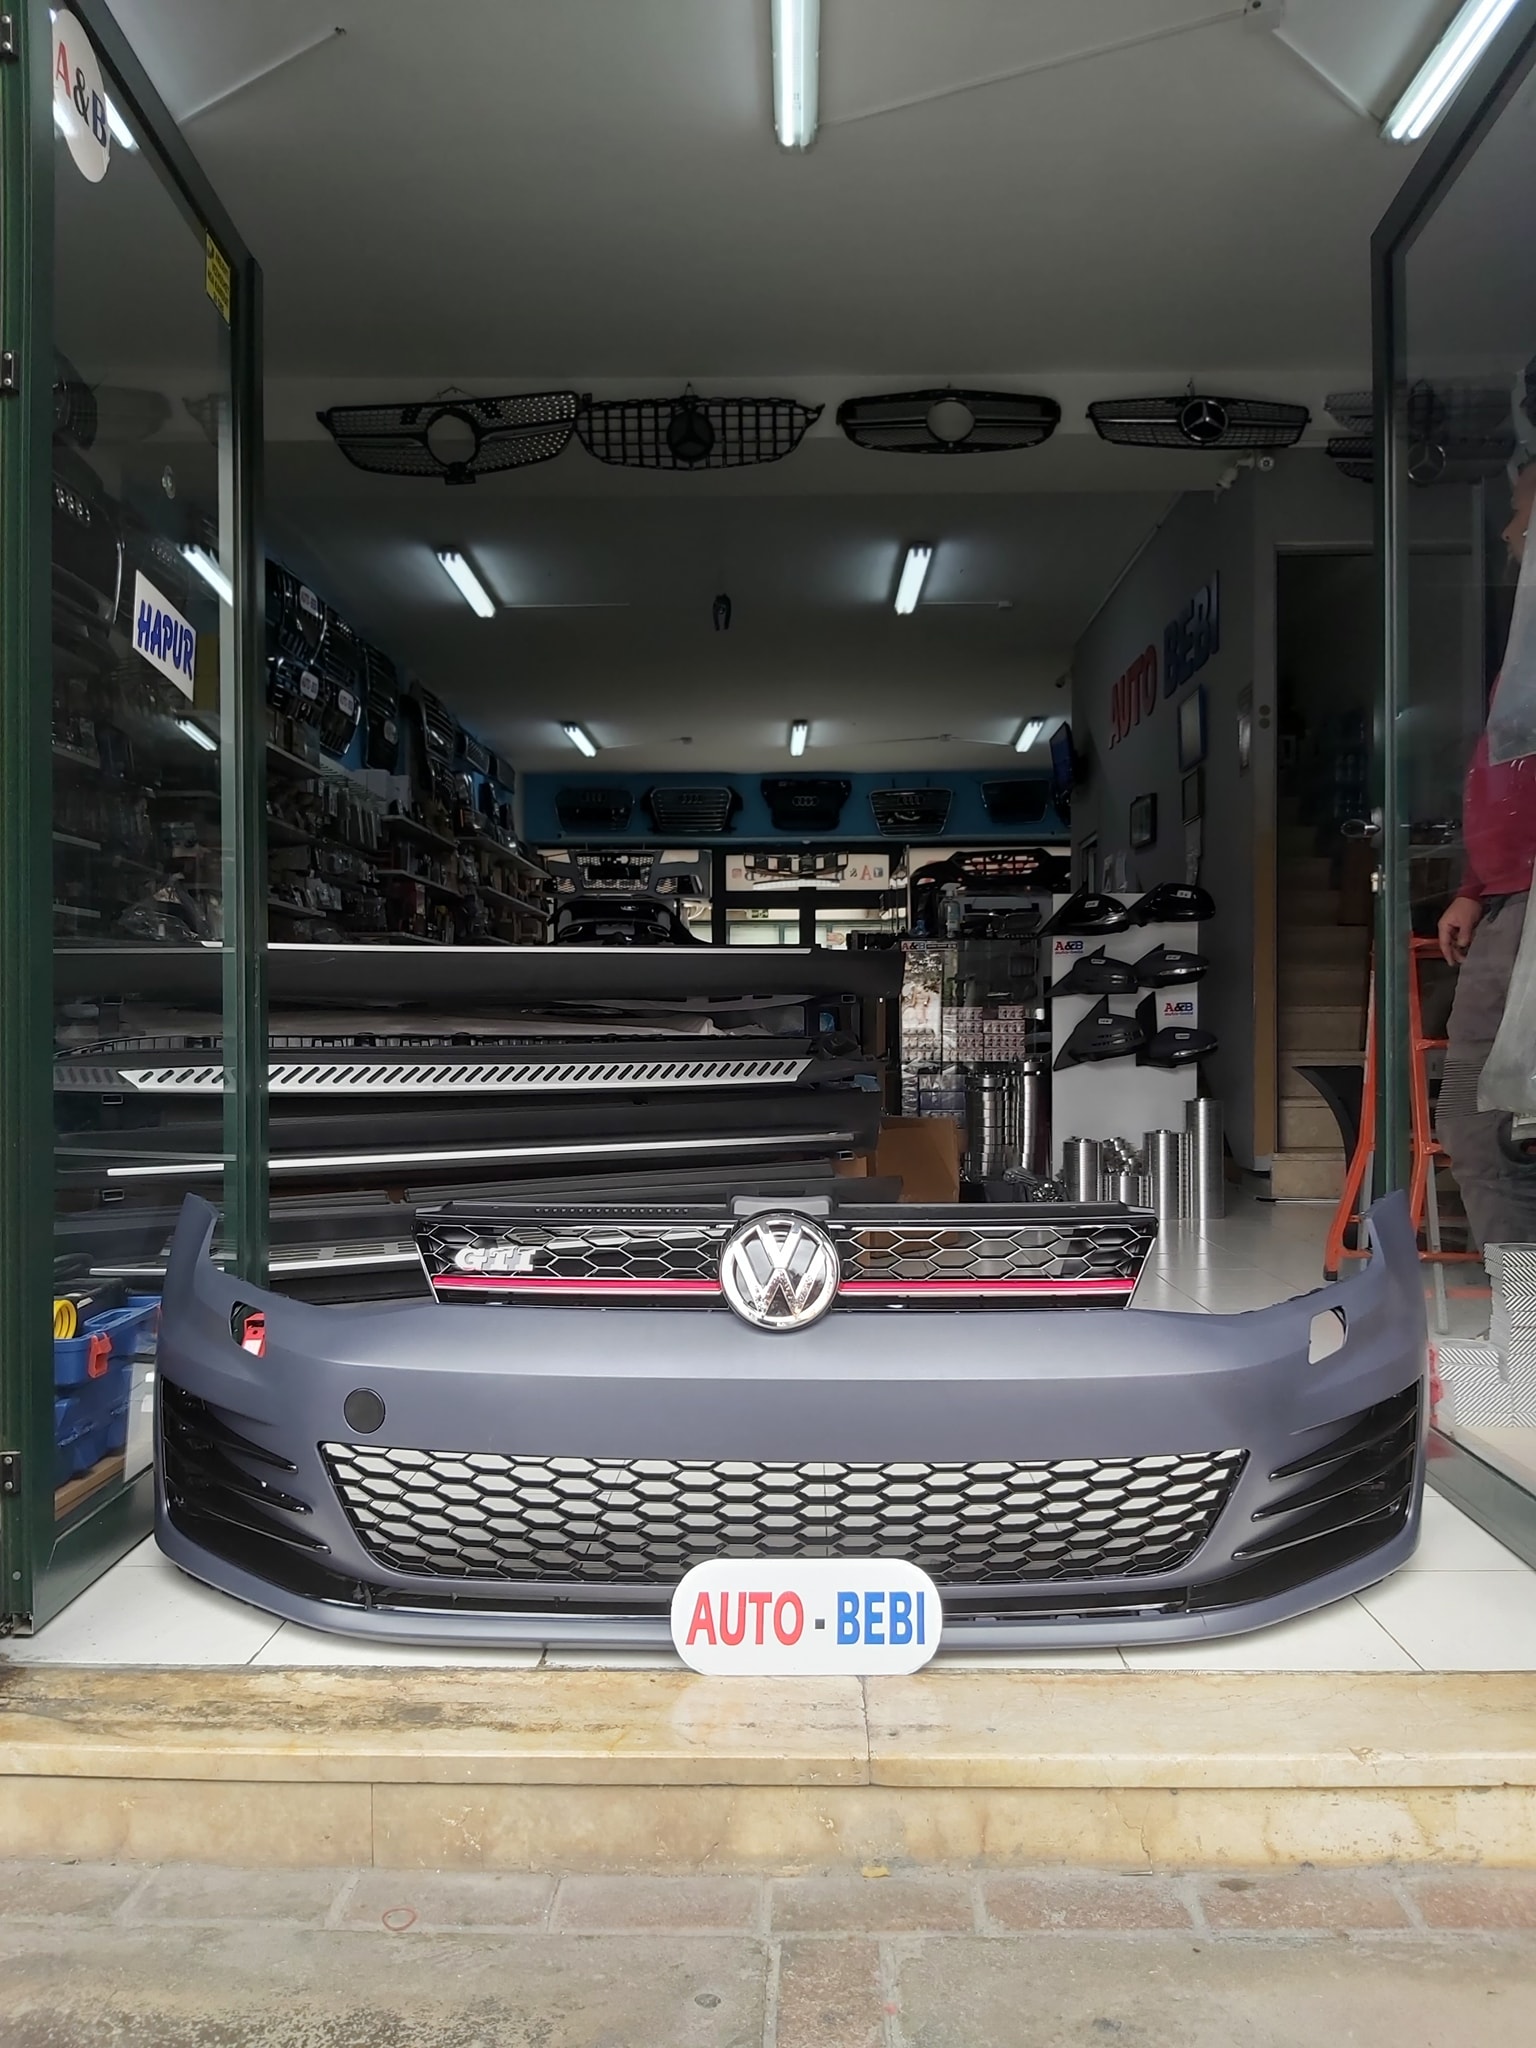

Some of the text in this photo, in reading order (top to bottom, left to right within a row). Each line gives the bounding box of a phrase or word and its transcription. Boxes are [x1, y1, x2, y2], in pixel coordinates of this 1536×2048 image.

[56, 41, 107, 148] A&B
[138, 599, 193, 681] HAPUR
[1110, 569, 1220, 750] AUTO BEBI
[455, 1245, 537, 1272] GTI
[685, 1590, 804, 1646] AUTO
[836, 1591, 926, 1645] BEBI
